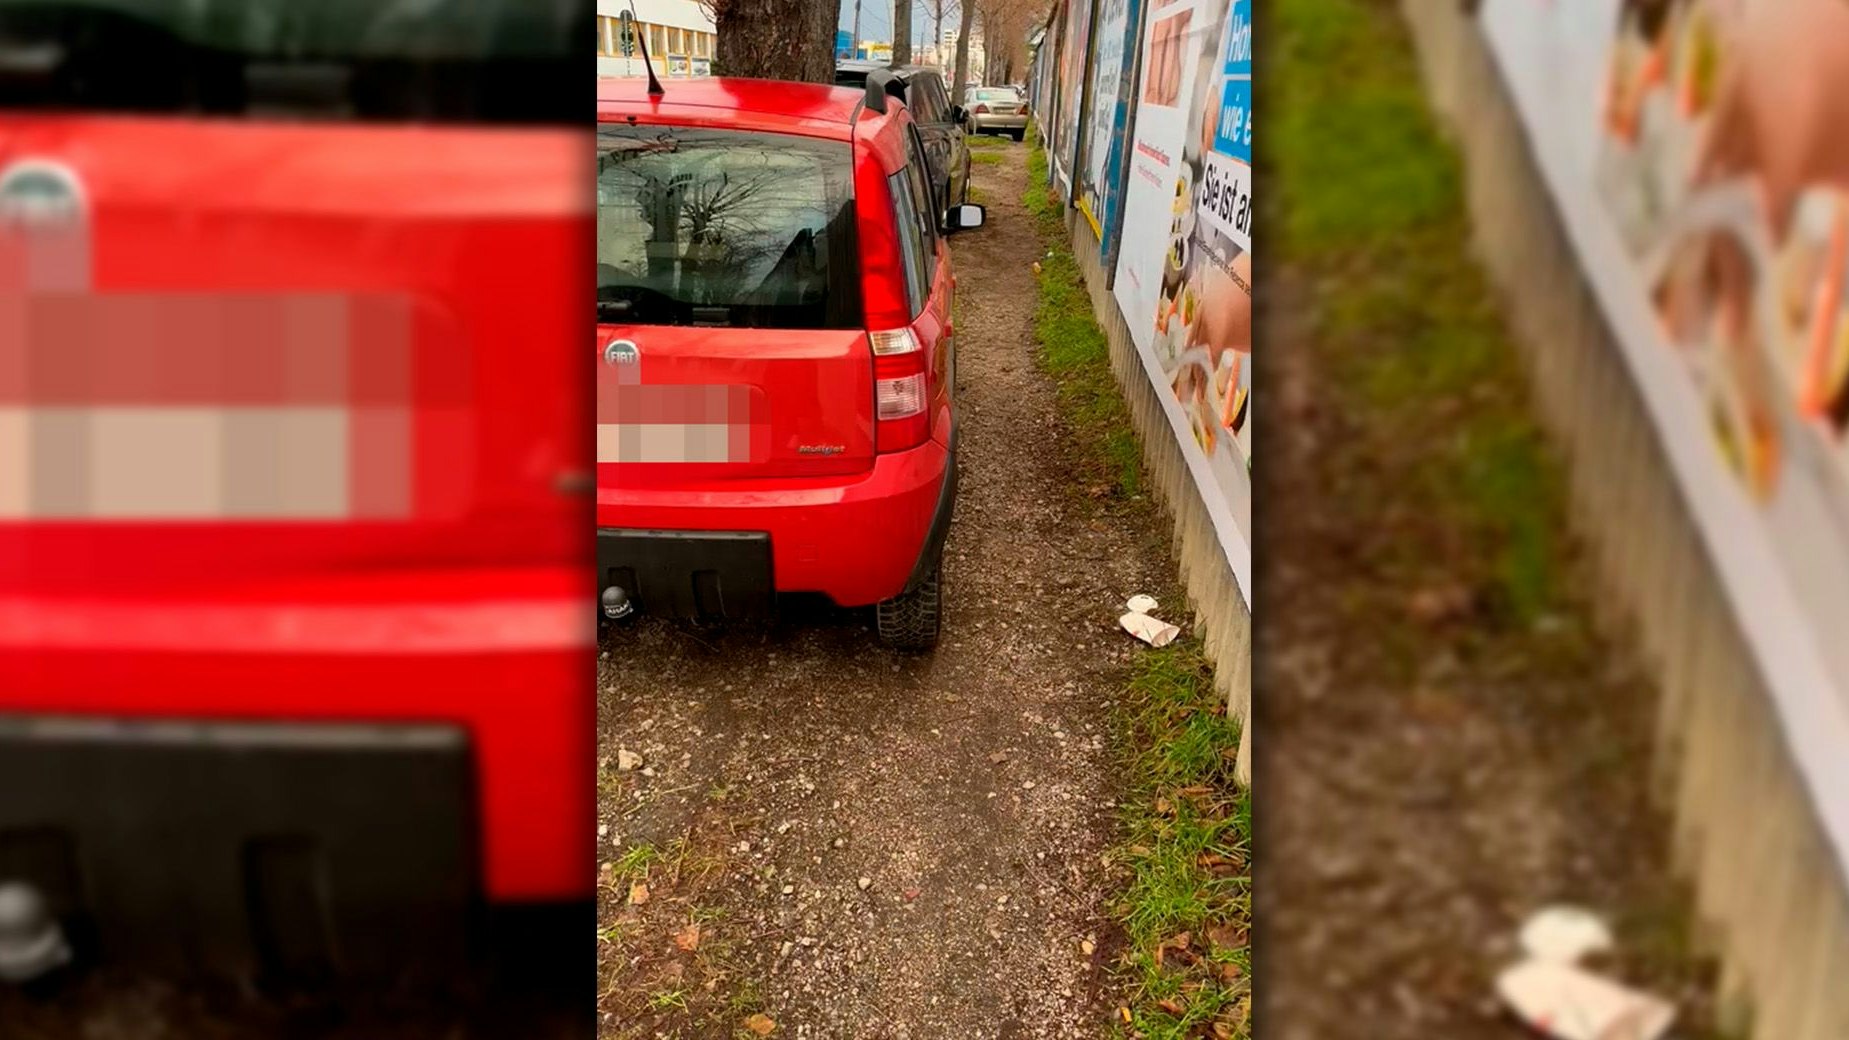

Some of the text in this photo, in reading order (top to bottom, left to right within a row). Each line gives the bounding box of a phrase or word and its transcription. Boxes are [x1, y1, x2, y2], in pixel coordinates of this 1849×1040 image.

[1221, 93, 1243, 142] wie
[1202, 163, 1219, 212] Sie
[1219, 171, 1237, 224] ist
[610, 351, 635, 364] FIAT
